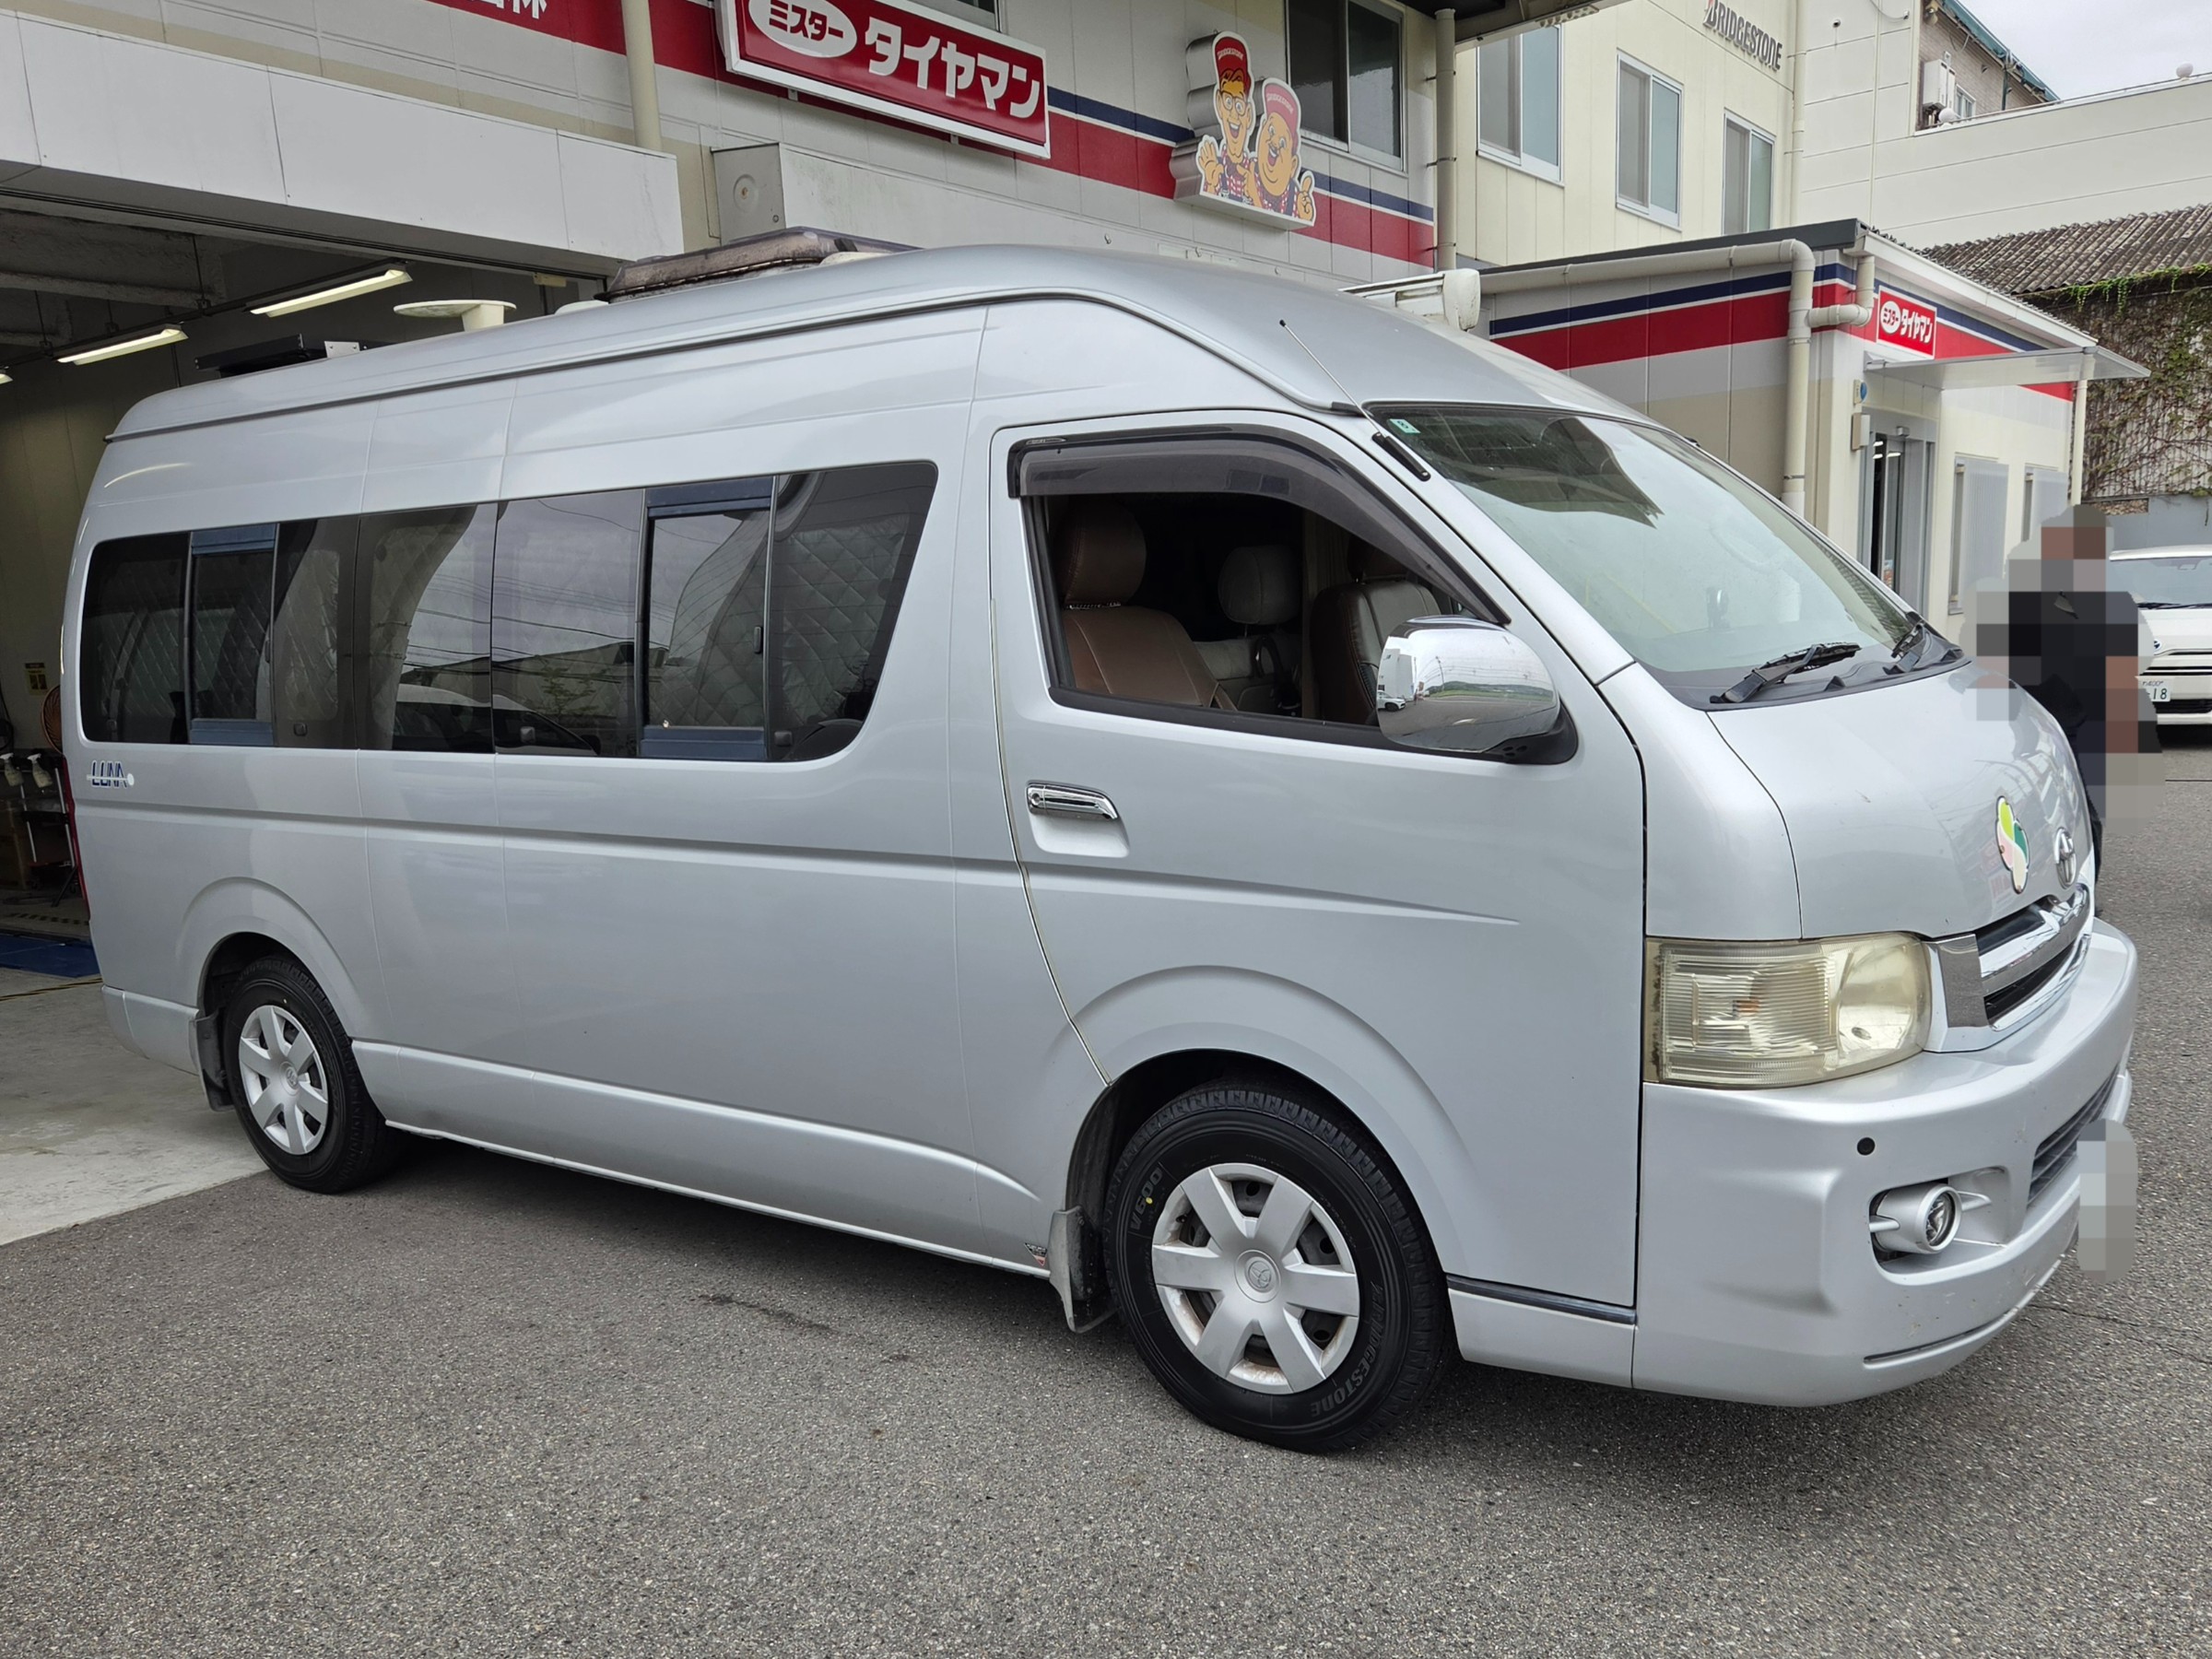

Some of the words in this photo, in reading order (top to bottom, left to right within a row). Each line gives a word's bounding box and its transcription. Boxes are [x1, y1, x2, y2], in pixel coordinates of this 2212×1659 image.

[769, 0, 844, 41] ミスター
[865, 17, 1041, 118] タイヤマン
[1702, 0, 1783, 72] BRIDGESTONE
[1900, 308, 1934, 344] タイヤマン
[91, 760, 127, 788] LUNA
[1130, 1167, 1163, 1230] V600
